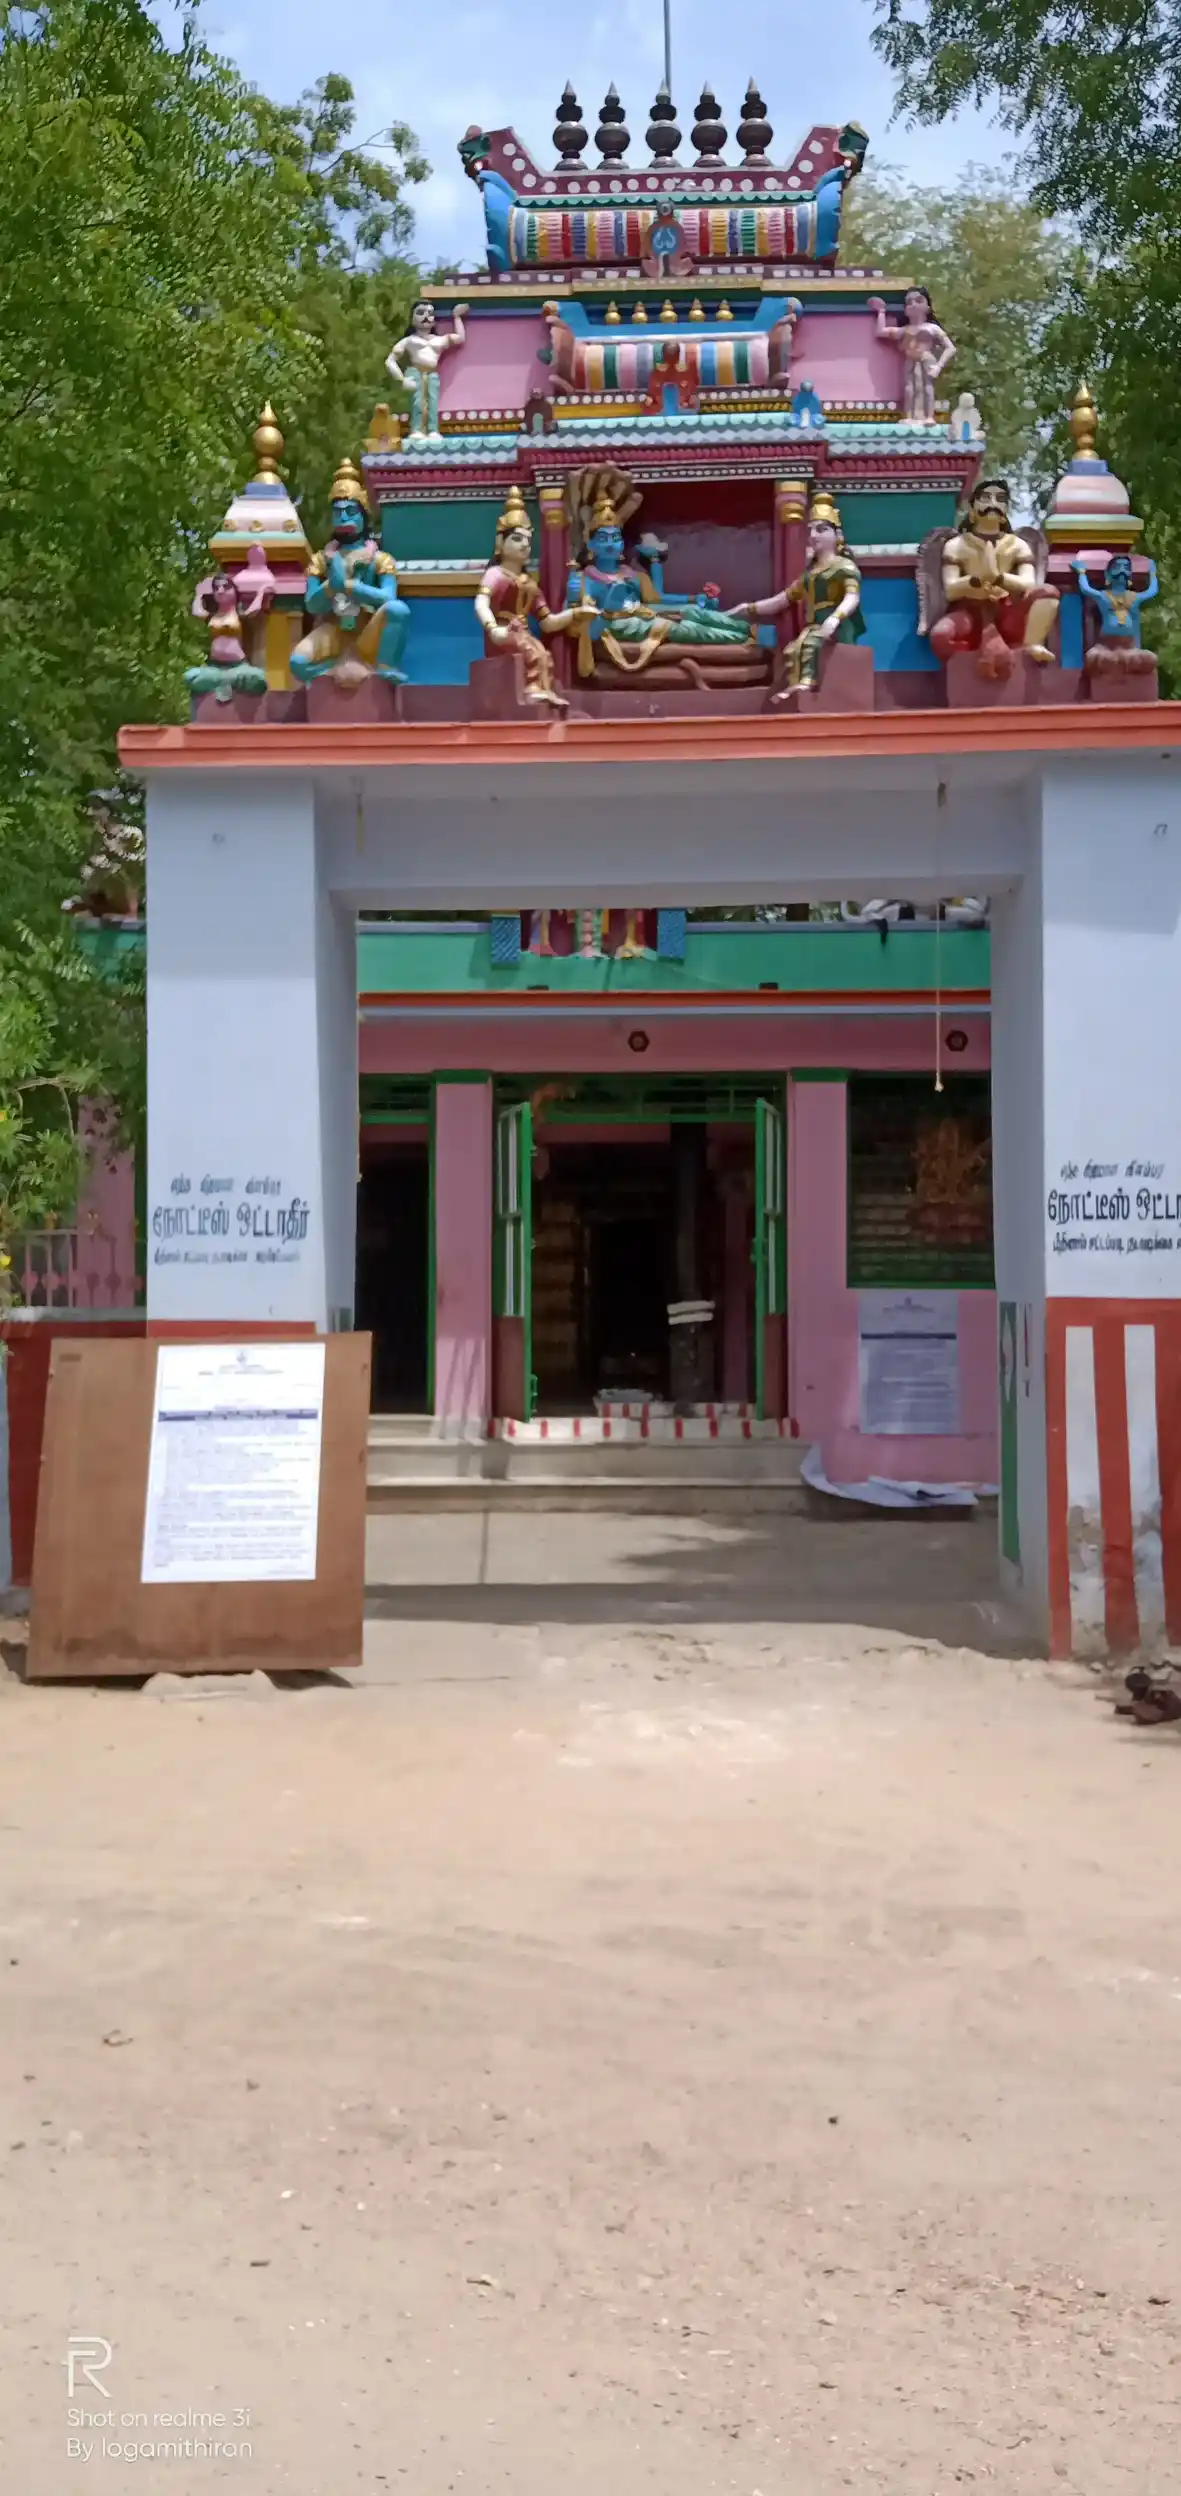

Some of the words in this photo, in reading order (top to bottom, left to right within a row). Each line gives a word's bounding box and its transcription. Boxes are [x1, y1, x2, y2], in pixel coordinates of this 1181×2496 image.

[152, 1200, 230, 1243] நோட்டீஸ்
[236, 1197, 310, 1245] ஒட்டாதீர்
[1047, 1187, 1131, 1226] நோட்டீஸ்
[1136, 1187, 1181, 1226] ஒட்டா
